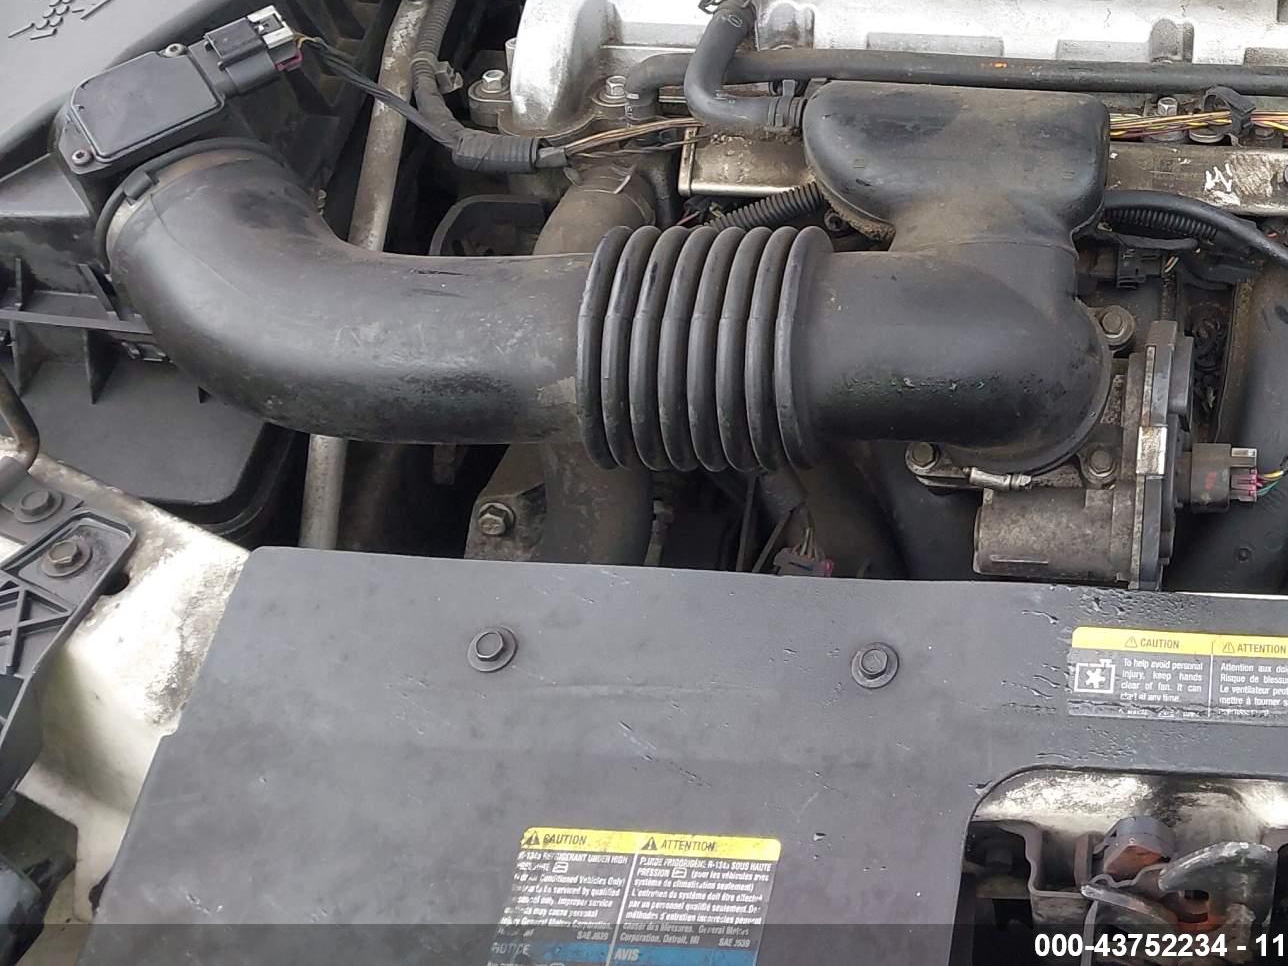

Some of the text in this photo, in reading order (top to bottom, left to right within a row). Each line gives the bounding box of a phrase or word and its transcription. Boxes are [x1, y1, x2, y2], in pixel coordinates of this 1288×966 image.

[1140, 637, 1180, 650] CAUTION
[1237, 643, 1287, 654] ATTENTION
[1124, 658, 1203, 671] To help avoid personal
[1221, 662, 1254, 671] Attention
[1153, 671, 1172, 681] keep
[1179, 673, 1202, 681] hands
[1220, 674, 1246, 683] Risque
[1250, 675, 1259, 683] de
[1120, 681, 1140, 690] clear
[1145, 682, 1153, 690] of
[1220, 684, 1229, 693] Le
[1231, 686, 1270, 694] ventilateur
[1147, 694, 1161, 702] any
[1254, 697, 1281, 706] tourner
[543, 833, 587, 845] CAUTION
[661, 840, 717, 852] ATTENTION
[587, 854, 610, 863] UNDER
[611, 855, 628, 864] HIGH
[731, 862, 750, 871] SOUS
[750, 863, 772, 872] HAUTE
[637, 867, 670, 877] PRESSION
[691, 870, 710, 880] (pour
[710, 870, 721, 879] les
[721, 871, 753, 881] véhicules
[664, 879, 672, 887] de
[707, 892, 721, 901] doit
[588, 899, 613, 907] service
[718, 938, 733, 947] SAE
[614, 948, 640, 961] AVIS
